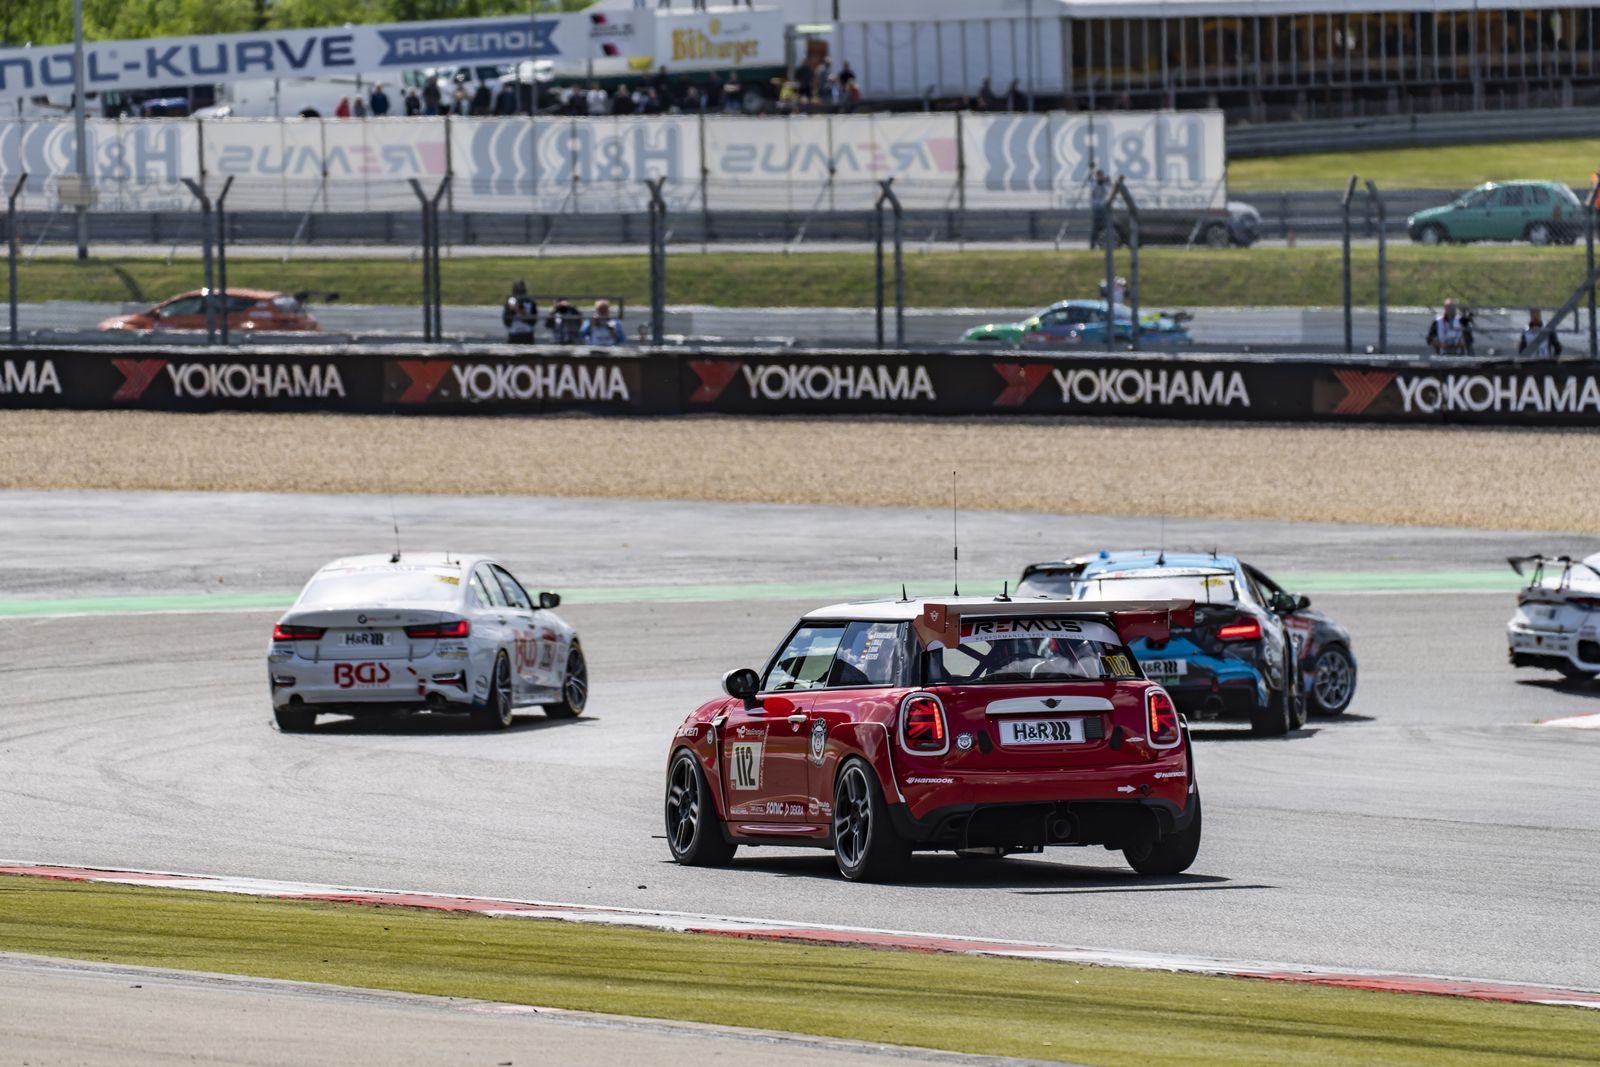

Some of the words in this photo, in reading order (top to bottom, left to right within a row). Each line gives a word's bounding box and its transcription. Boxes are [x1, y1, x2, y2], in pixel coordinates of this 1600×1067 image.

[395, 30, 543, 56] RAVENOL
[0, 360, 62, 394] MA
[167, 363, 345, 397] YOKOHAMA
[453, 364, 629, 400] YOKOHAMA
[743, 364, 935, 400] YOKOHAMA
[1053, 368, 1250, 407] YOKOHAMA
[1396, 374, 1600, 412] YOKOHAMA
[974, 619, 1083, 635] REMUS
[1105, 655, 1136, 677] 112
[1012, 722, 1050, 740] H&R
[735, 746, 756, 787] 112
[766, 802, 783, 814] SONIC
